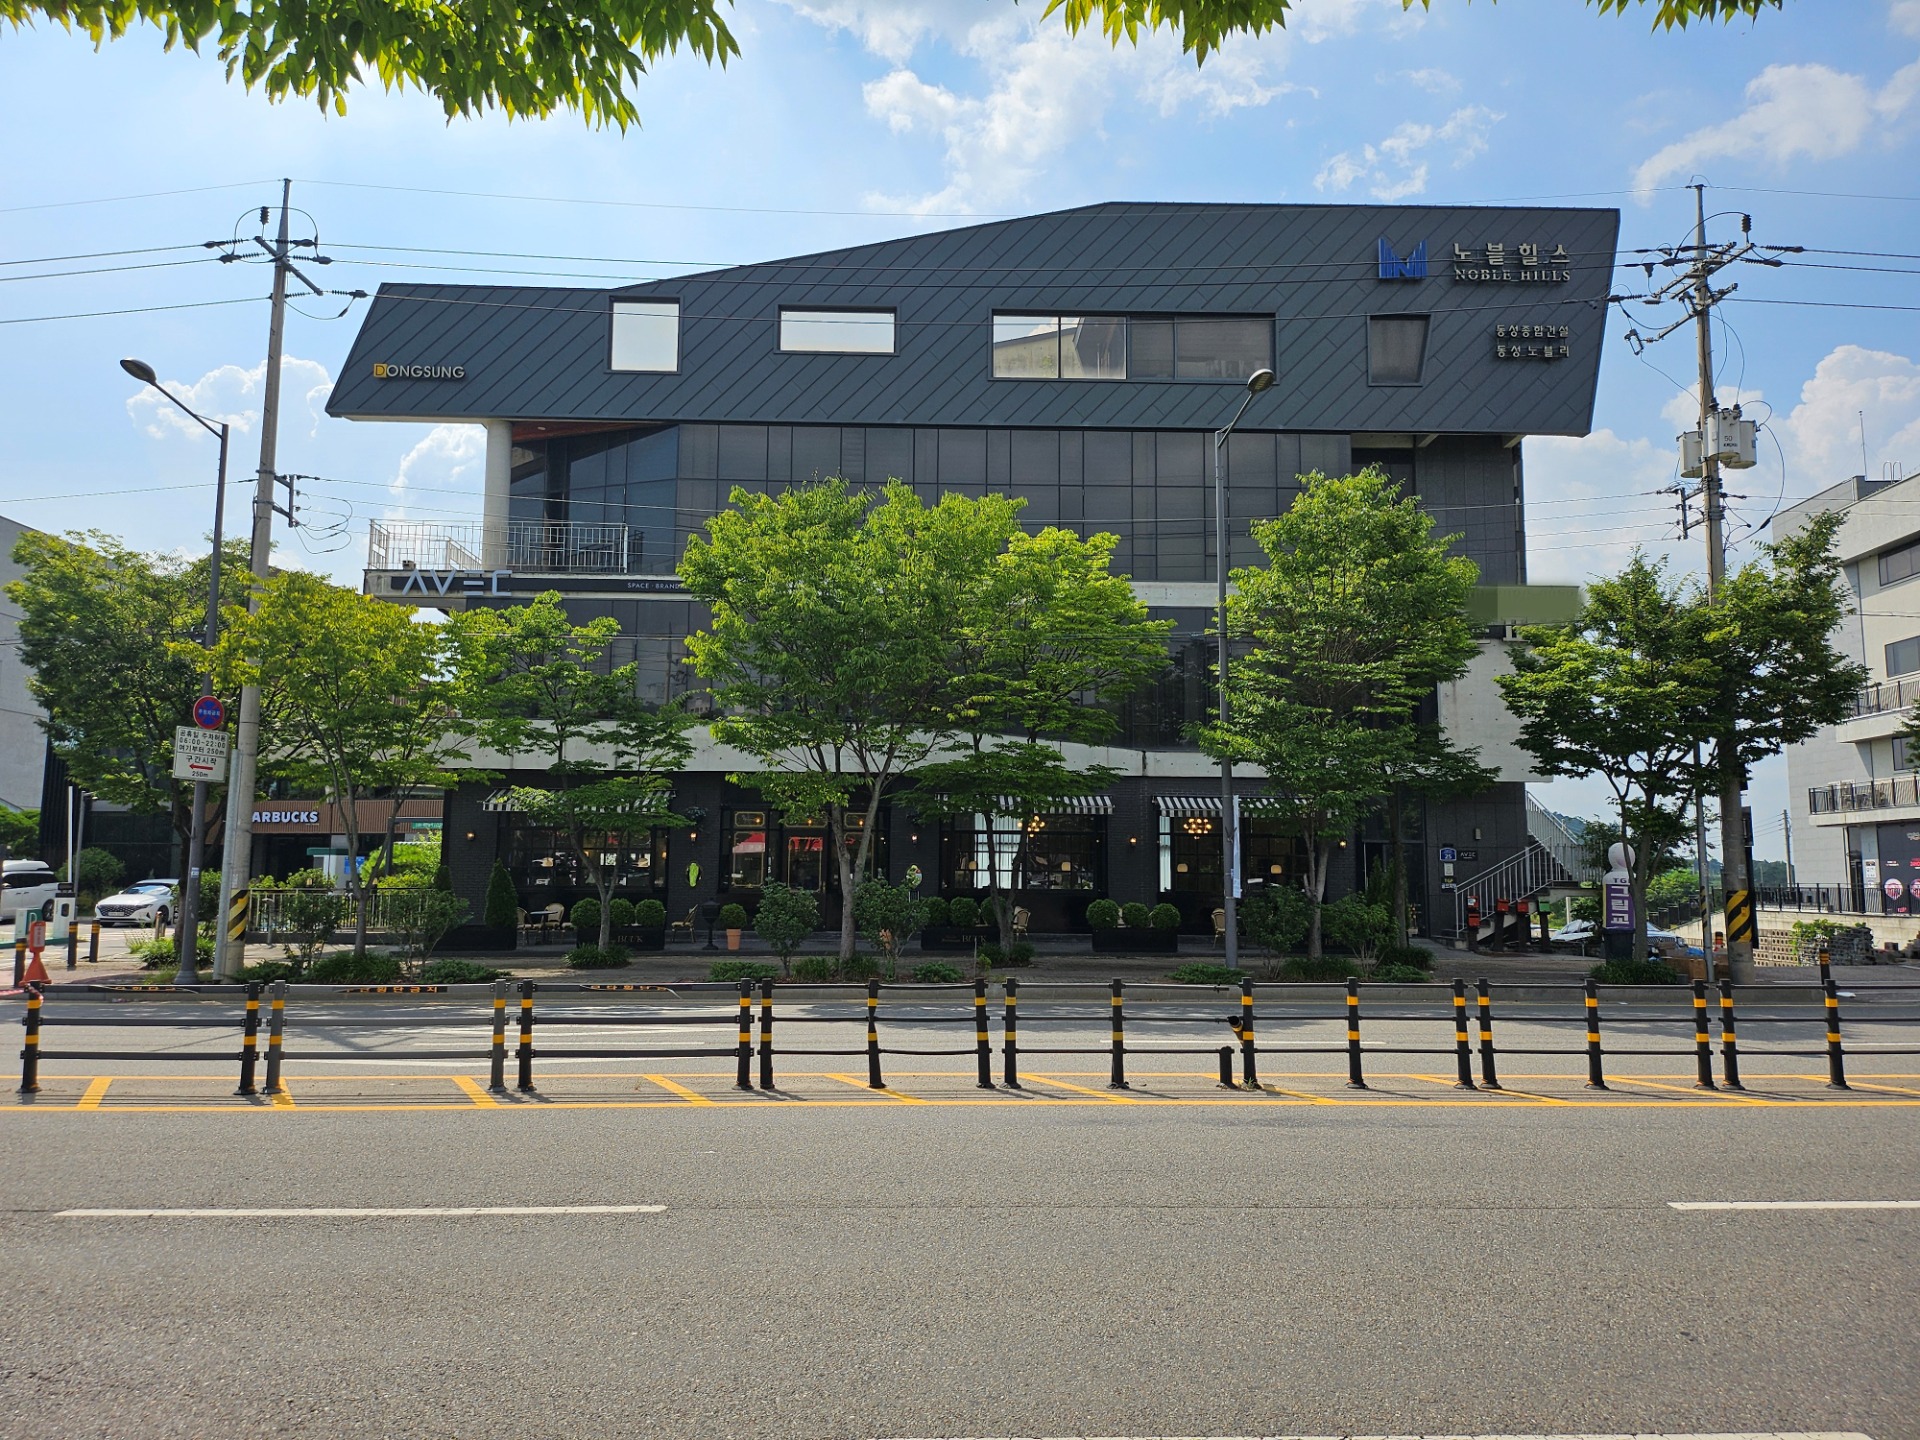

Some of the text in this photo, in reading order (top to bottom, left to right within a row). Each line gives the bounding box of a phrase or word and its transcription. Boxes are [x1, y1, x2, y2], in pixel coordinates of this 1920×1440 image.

[1453, 242, 1571, 266] 노블힐스
[1454, 269, 1571, 282] NOBLE HILLS
[1496, 324, 1570, 338] 동성종합건설
[374, 363, 465, 378] DONGSUNG
[401, 569, 513, 596] AVEC
[178, 744, 225, 756] 여기부터 250m
[186, 755, 217, 765] 구간시작
[191, 770, 209, 778] 250m
[252, 811, 319, 823] ARBUCKS
